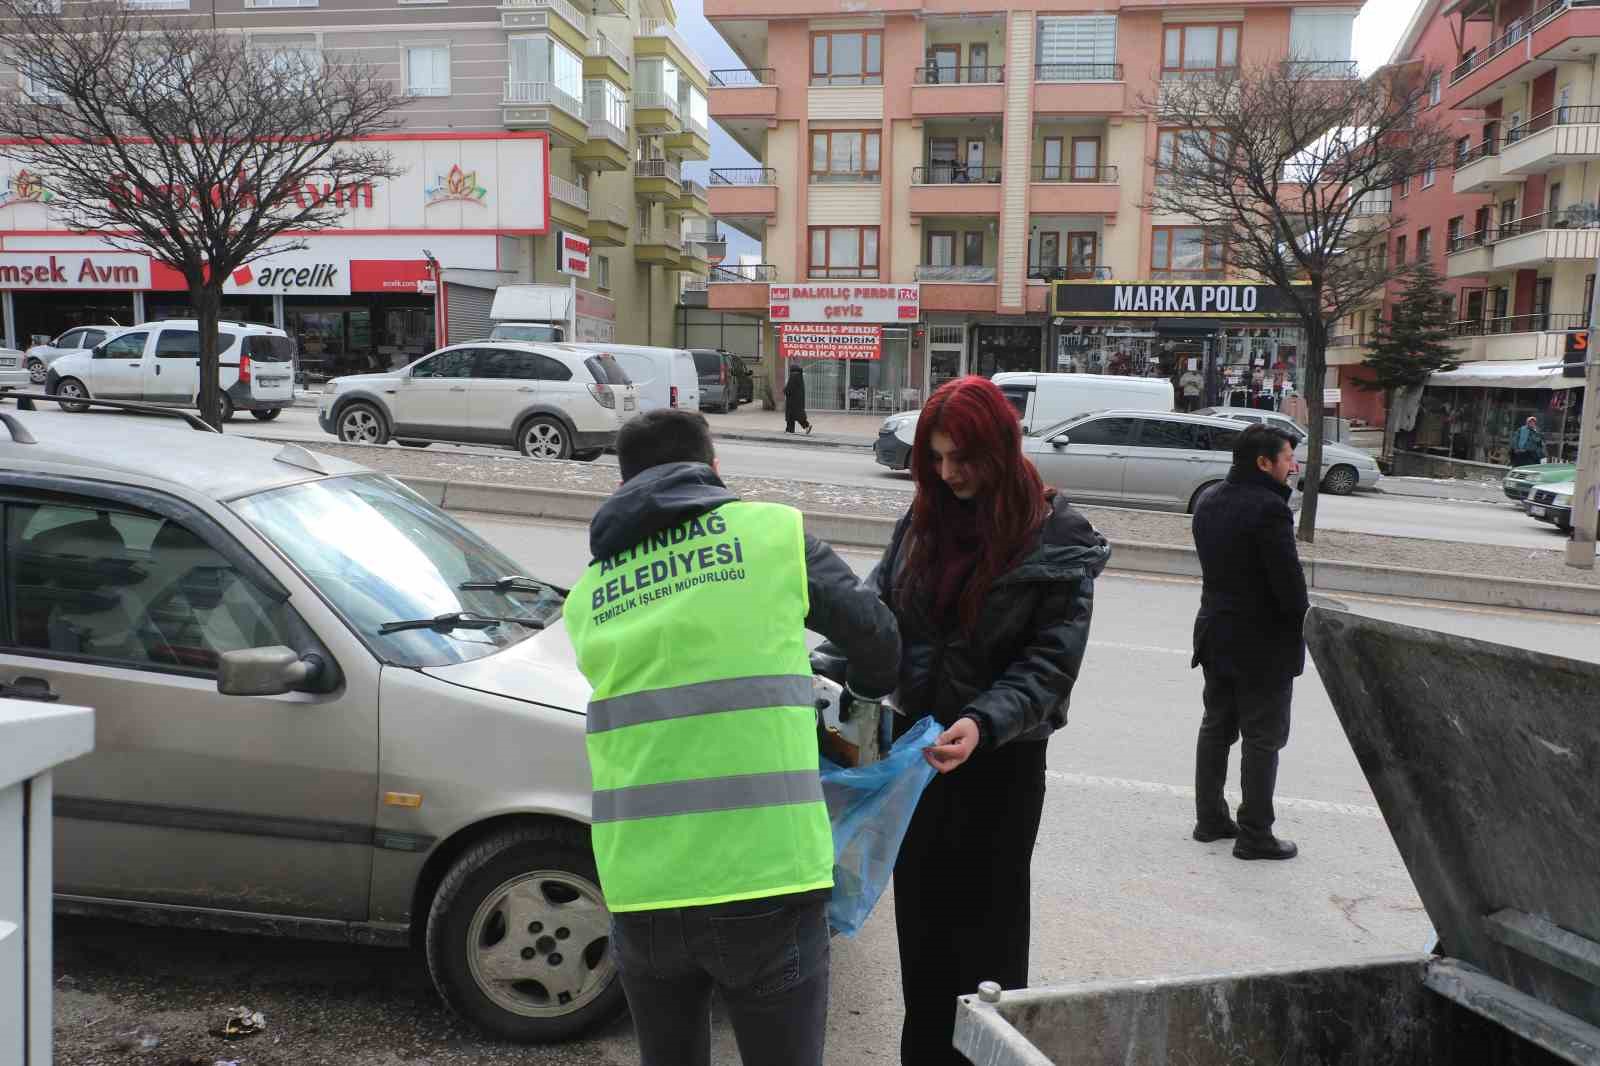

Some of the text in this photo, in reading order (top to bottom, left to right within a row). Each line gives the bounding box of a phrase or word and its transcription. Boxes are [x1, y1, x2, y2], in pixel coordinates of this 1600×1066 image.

[77, 257, 139, 283] Avm
[258, 264, 338, 291] arçelik
[854, 288, 896, 299] PERDE
[1113, 285, 1257, 312] MARKA POLO
[786, 335, 825, 344] BÜYÜK
[592, 537, 743, 611] BELEDİYESİ
